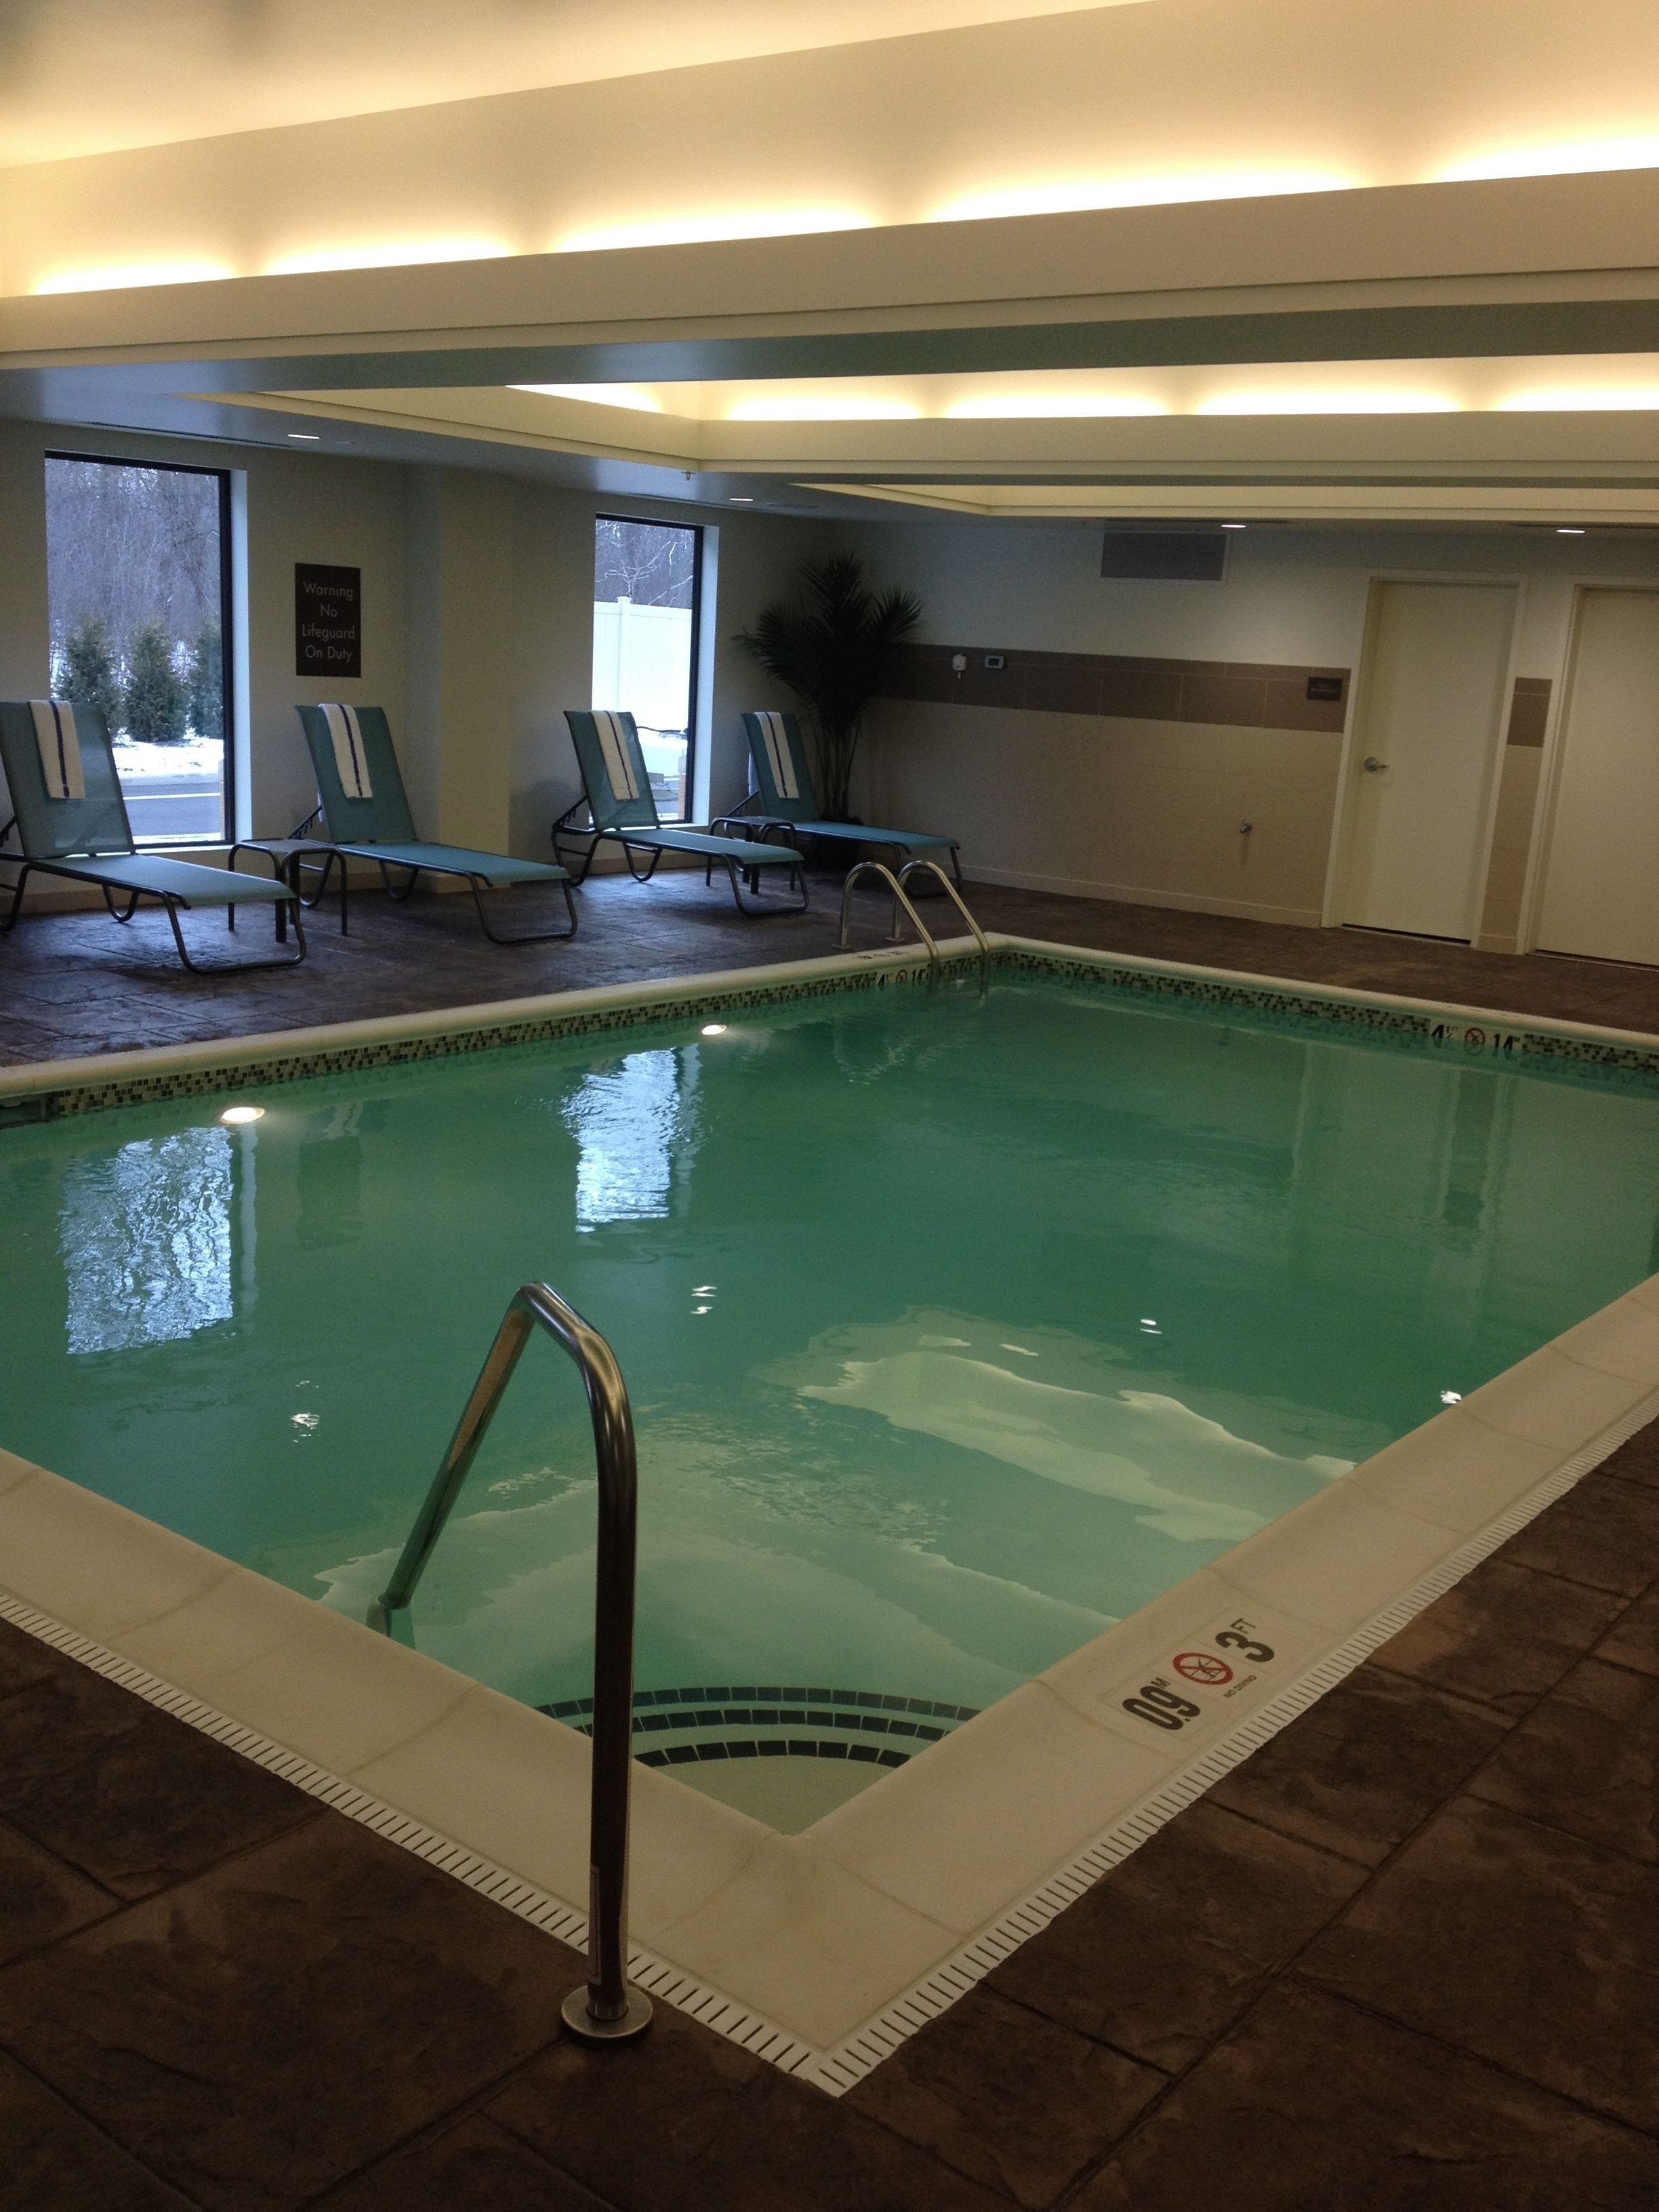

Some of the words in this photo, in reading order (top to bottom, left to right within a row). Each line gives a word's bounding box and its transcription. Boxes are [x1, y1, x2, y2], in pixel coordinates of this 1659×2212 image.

[303, 581, 354, 601] Warning
[320, 604, 338, 617] No
[302, 622, 355, 642] Lifeguard
[304, 644, 323, 659] On
[327, 646, 353, 664] Duty
